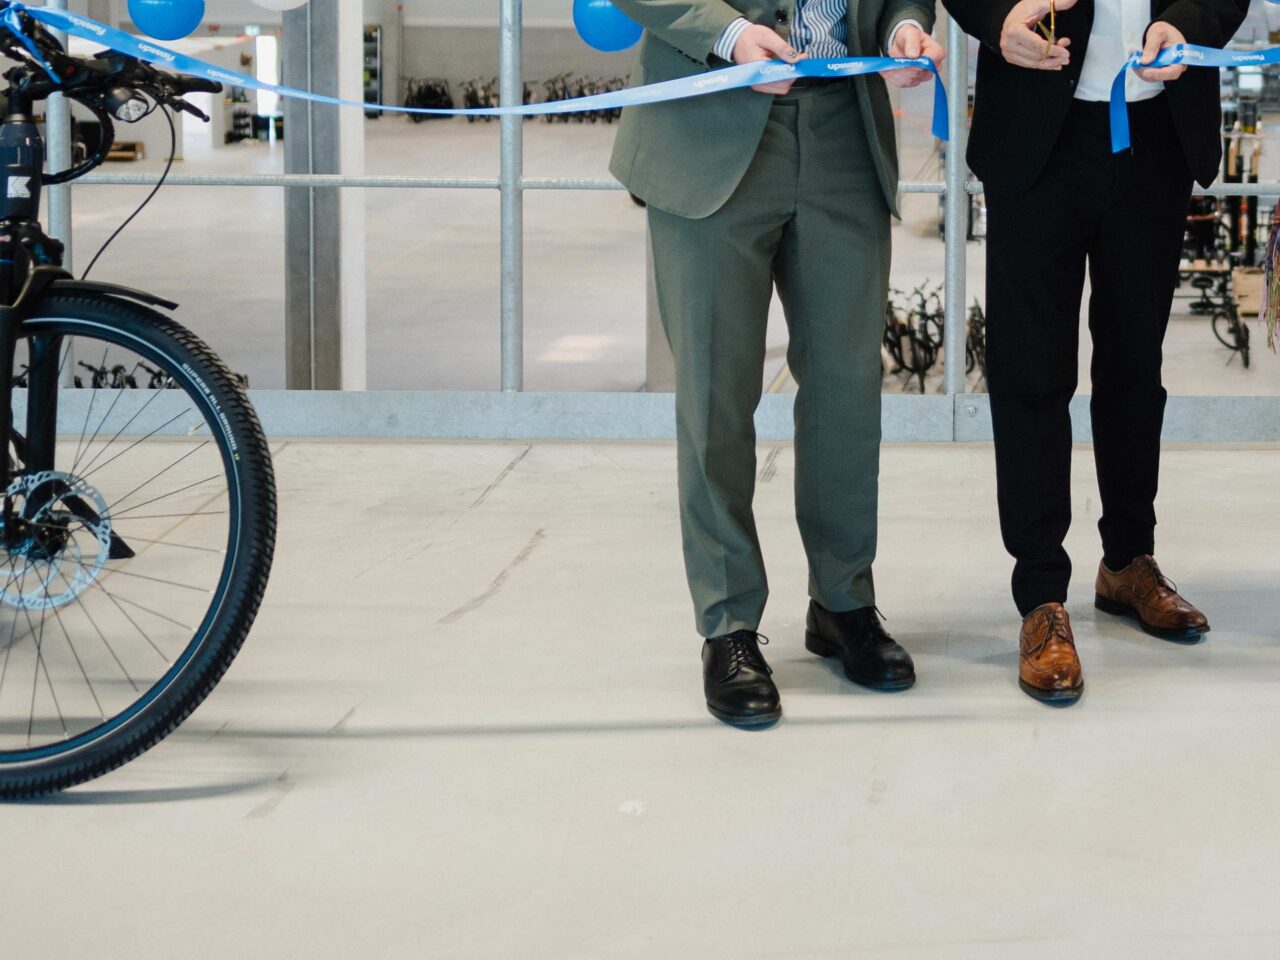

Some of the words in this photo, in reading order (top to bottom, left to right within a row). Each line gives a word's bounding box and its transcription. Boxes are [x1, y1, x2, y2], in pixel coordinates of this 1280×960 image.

[68, 16, 107, 36] upway
[137, 43, 175, 62] upway
[208, 395, 221, 413] ALL
